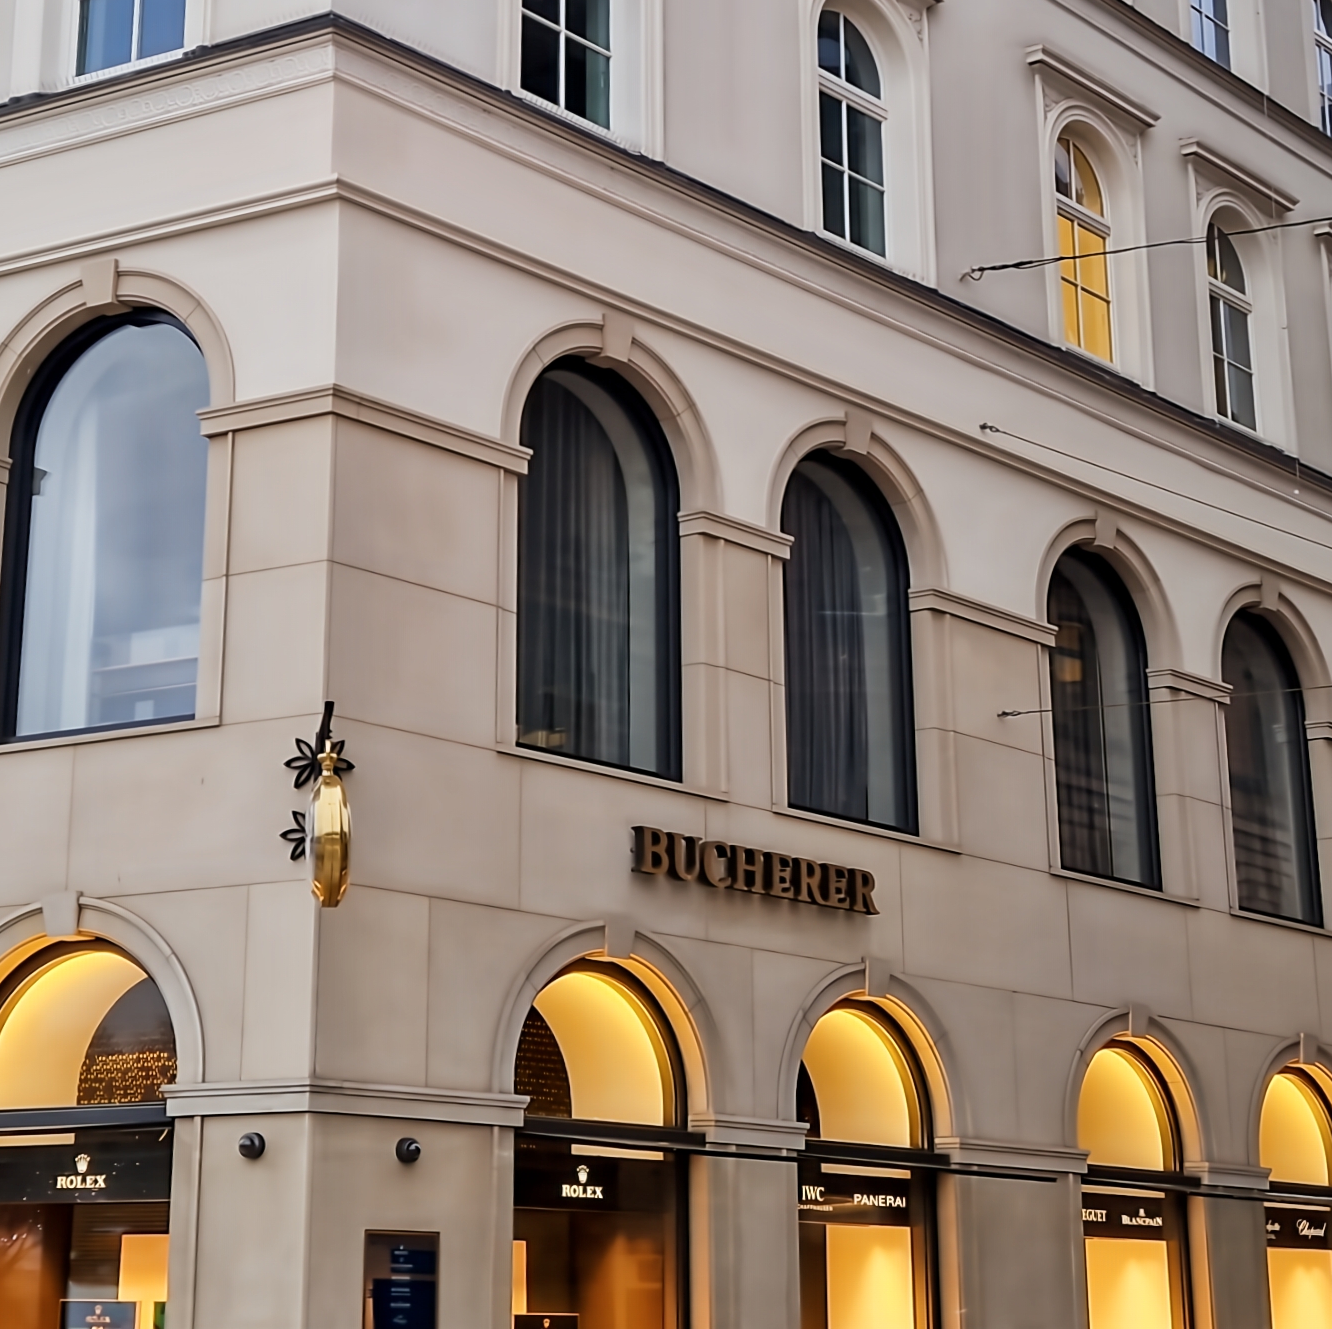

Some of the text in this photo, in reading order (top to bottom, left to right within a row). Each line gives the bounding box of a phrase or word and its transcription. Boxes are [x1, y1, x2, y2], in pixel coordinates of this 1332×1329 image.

[632, 826, 881, 915] BUCHERER
[56, 1174, 107, 1189] ROLEX
[561, 1184, 604, 1199] ROLEX
[801, 1184, 825, 1202] IWC
[853, 1193, 907, 1208] PANERAI
[1081, 1208, 1107, 1222] EGUET
